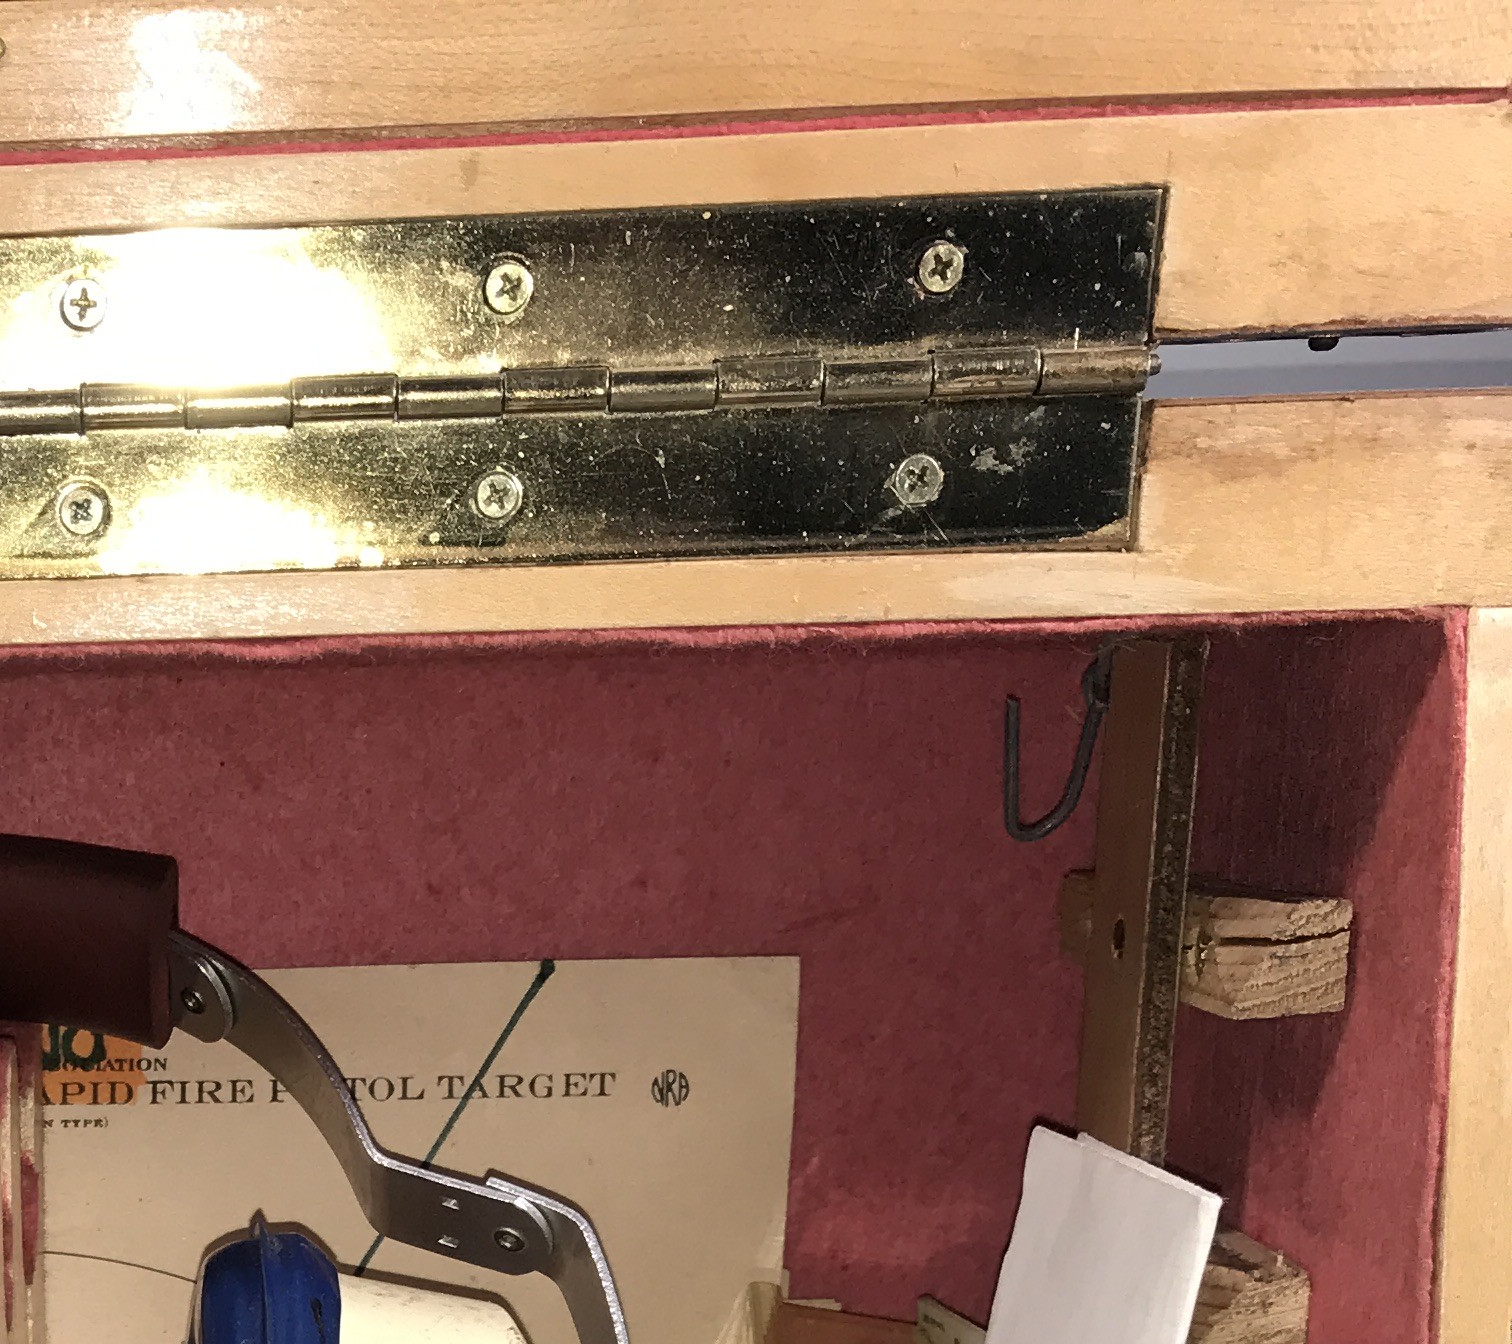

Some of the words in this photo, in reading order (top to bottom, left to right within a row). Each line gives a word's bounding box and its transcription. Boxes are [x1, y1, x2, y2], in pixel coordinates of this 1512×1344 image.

[146, 1079, 254, 1105] FIRE
[437, 1071, 617, 1101] TARGET
[60, 1118, 109, 1129] TYPE)
